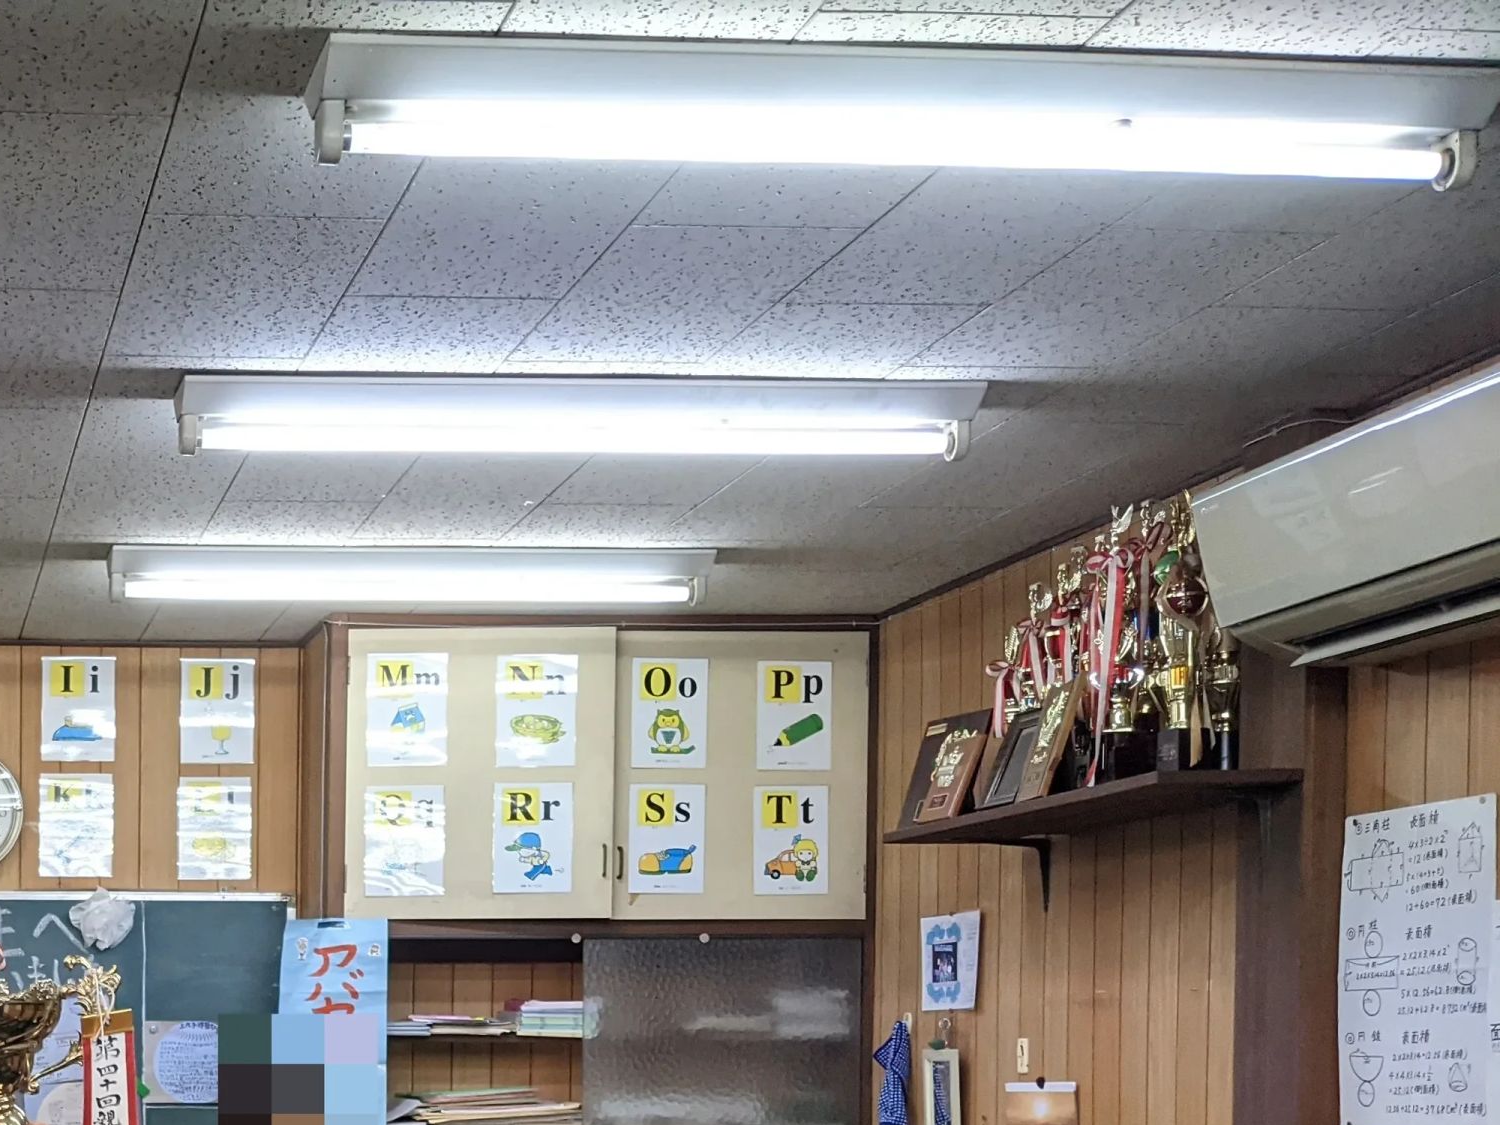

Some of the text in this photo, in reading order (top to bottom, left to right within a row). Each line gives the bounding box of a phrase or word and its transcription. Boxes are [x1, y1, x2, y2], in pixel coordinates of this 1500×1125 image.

[60, 665, 100, 693] Ii
[196, 666, 240, 700] Jj
[643, 666, 698, 698] Oo
[770, 670, 824, 703] Pp
[507, 792, 561, 822] Rr
[643, 792, 691, 824] Ss
[766, 795, 815, 825] Tt
